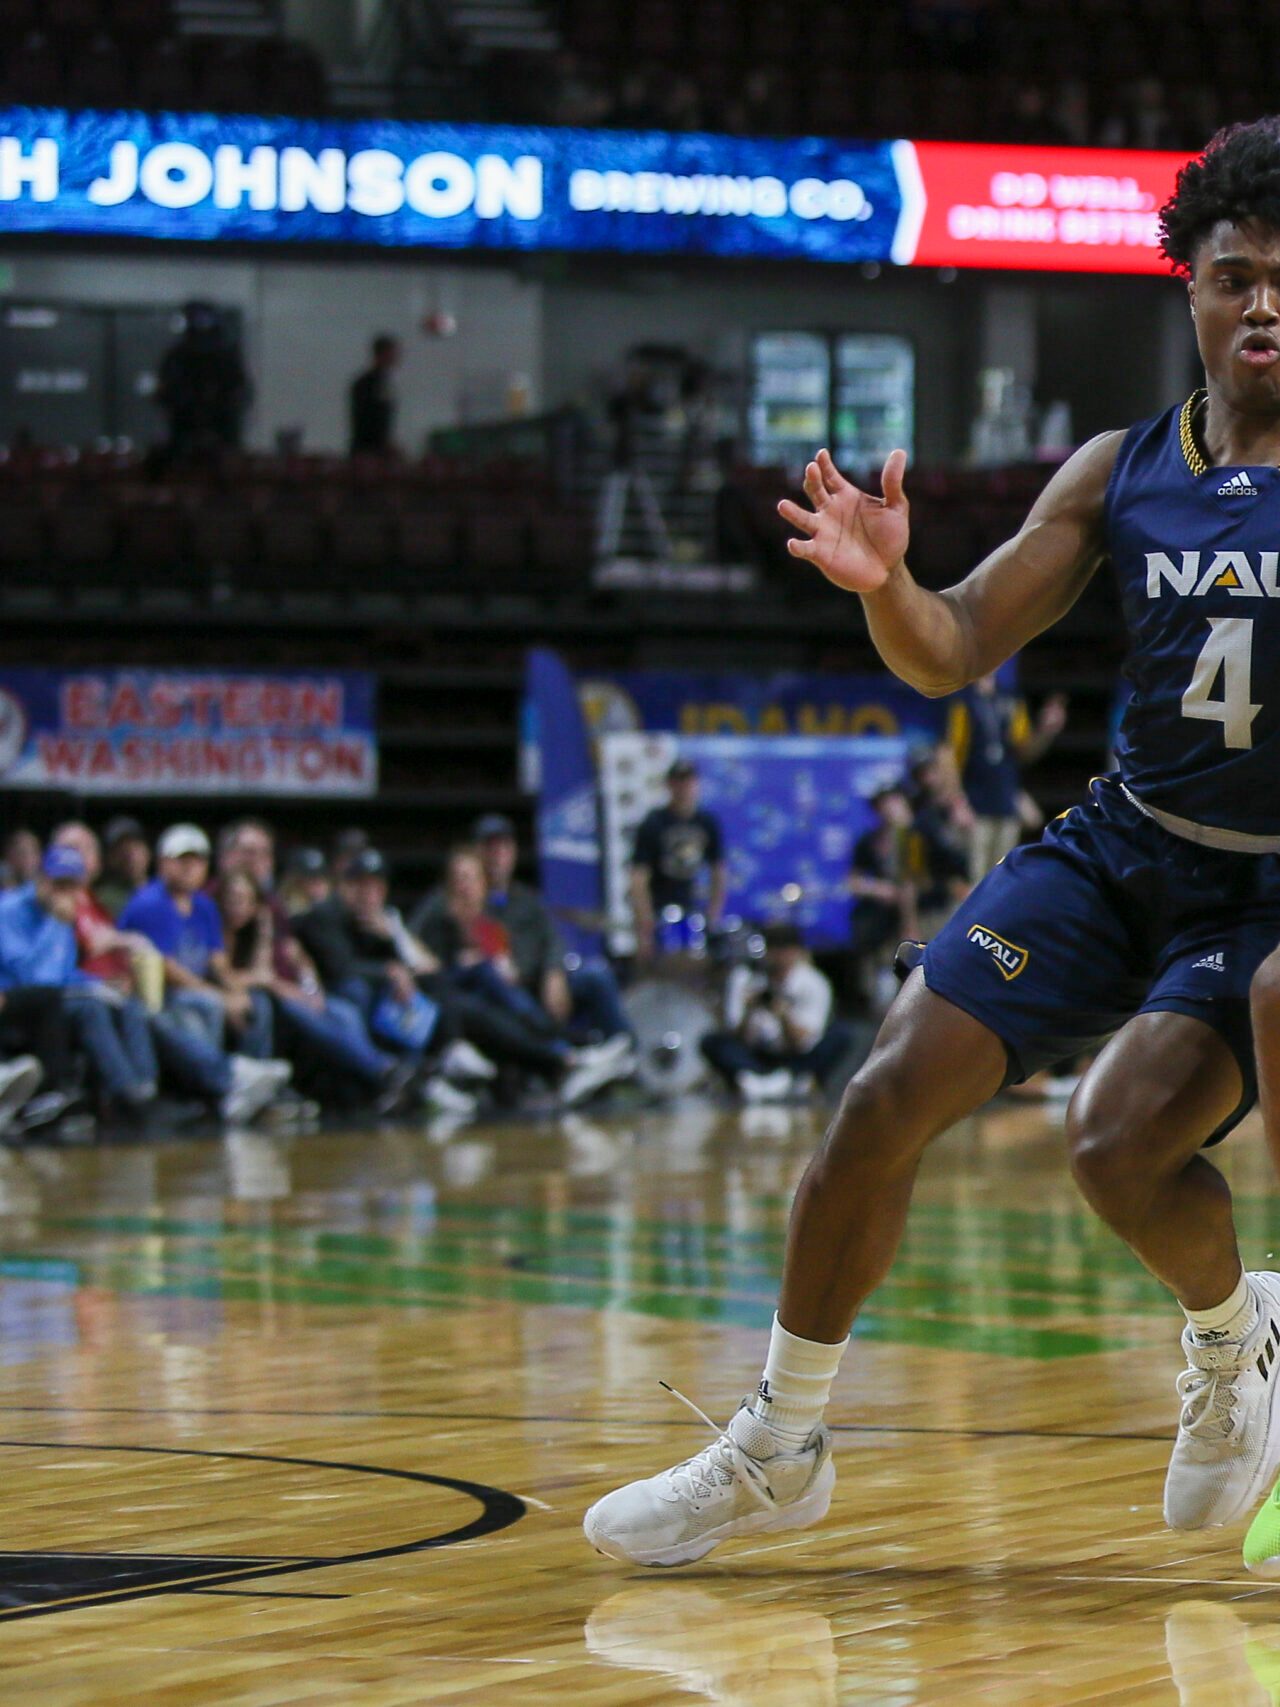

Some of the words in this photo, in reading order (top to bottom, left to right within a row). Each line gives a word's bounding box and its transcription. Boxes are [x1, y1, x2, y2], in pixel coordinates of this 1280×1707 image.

[88, 140, 543, 220] JOHNSON
[570, 169, 787, 218] BREWING
[1218, 486, 1257, 496] adidas
[62, 677, 345, 730] EASTERN
[1181, 617, 1263, 750] 4
[38, 734, 367, 781] WASHINGTON
[970, 930, 1020, 969] NAU
